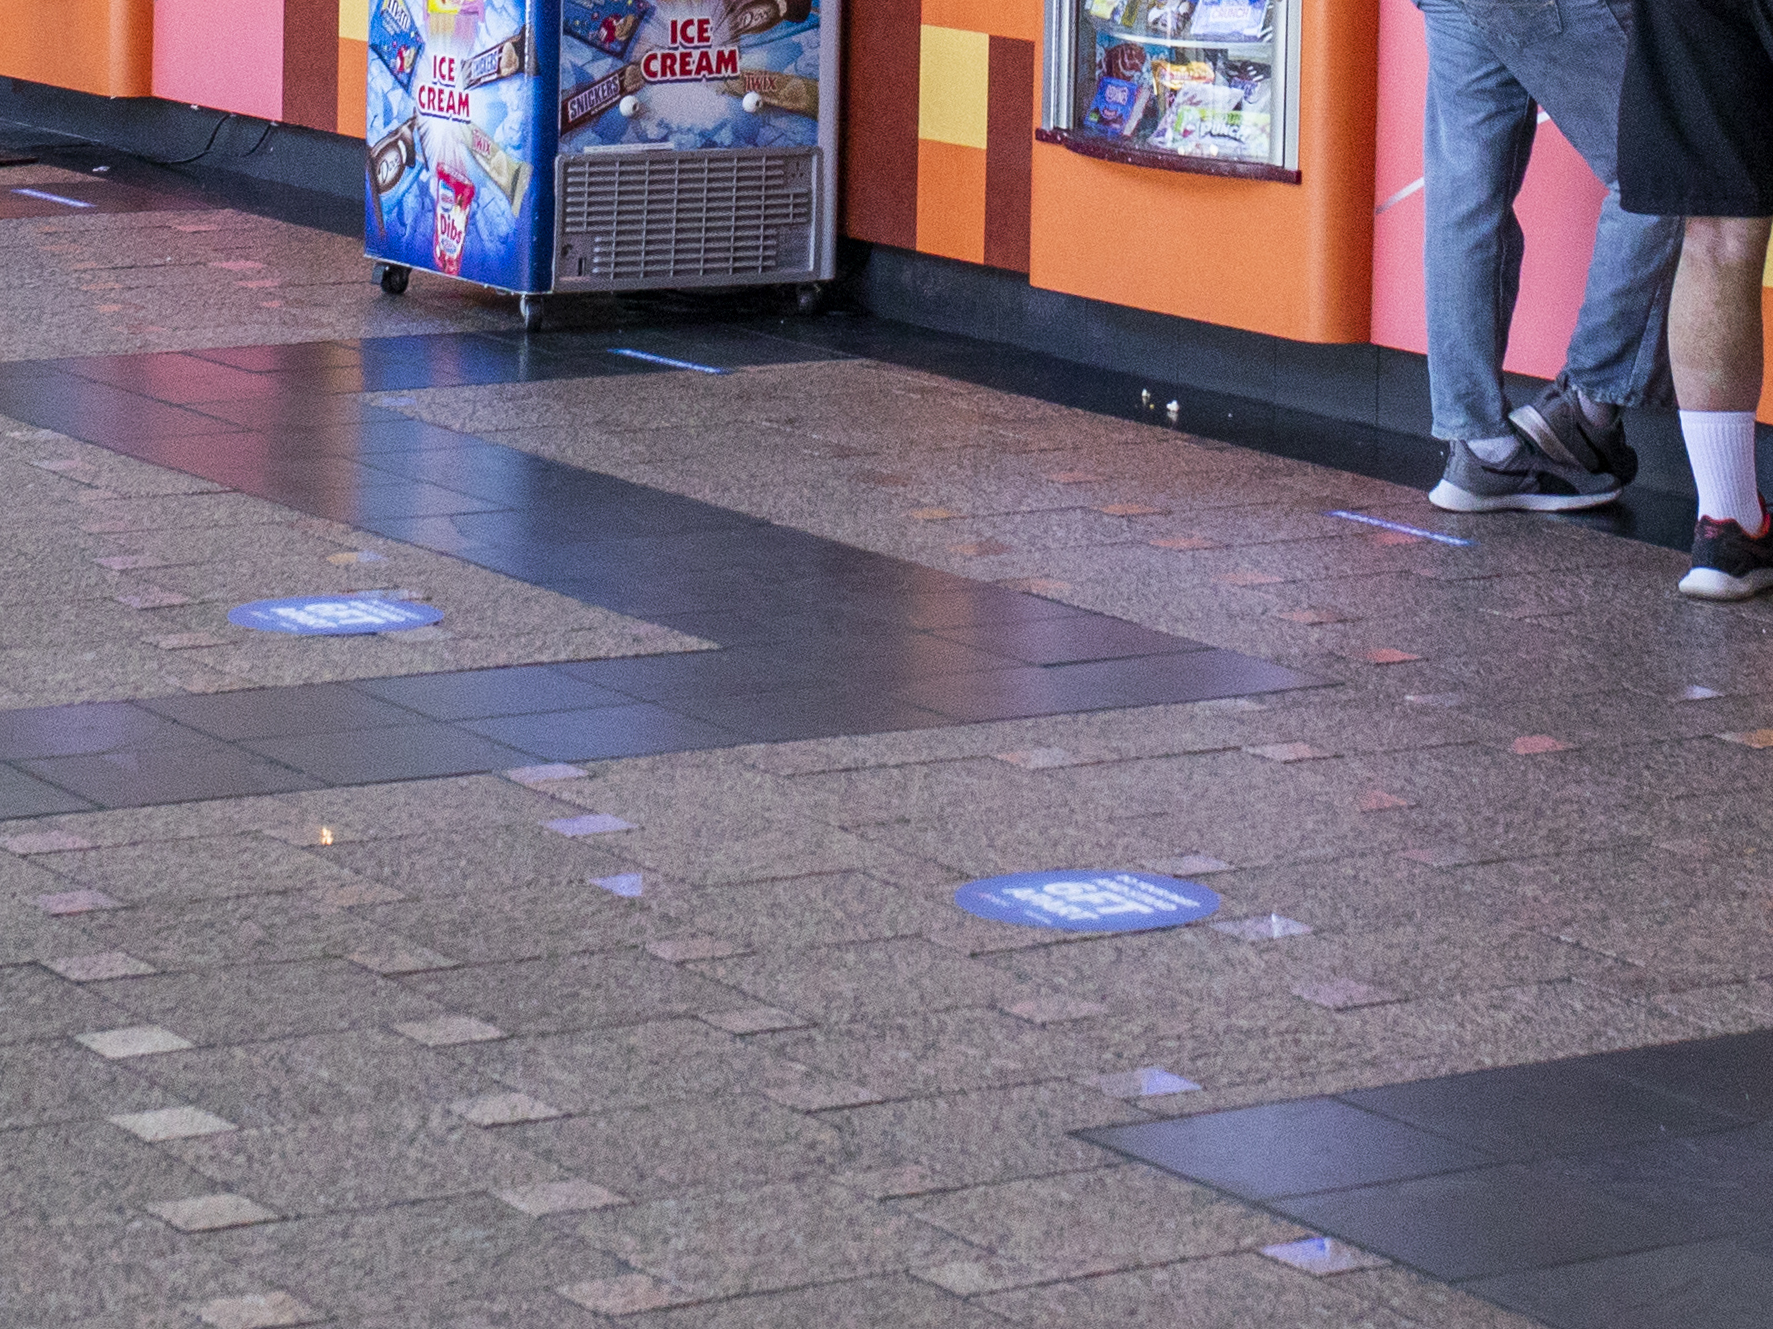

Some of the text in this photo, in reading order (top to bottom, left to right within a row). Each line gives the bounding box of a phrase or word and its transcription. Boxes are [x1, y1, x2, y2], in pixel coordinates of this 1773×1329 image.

[670, 19, 711, 44] ICE
[432, 55, 455, 82] ICE
[642, 49, 738, 78] CREAM
[418, 86, 470, 117] CREAM
[569, 75, 619, 120] SNICKERS
[440, 214, 463, 243] Dibs
